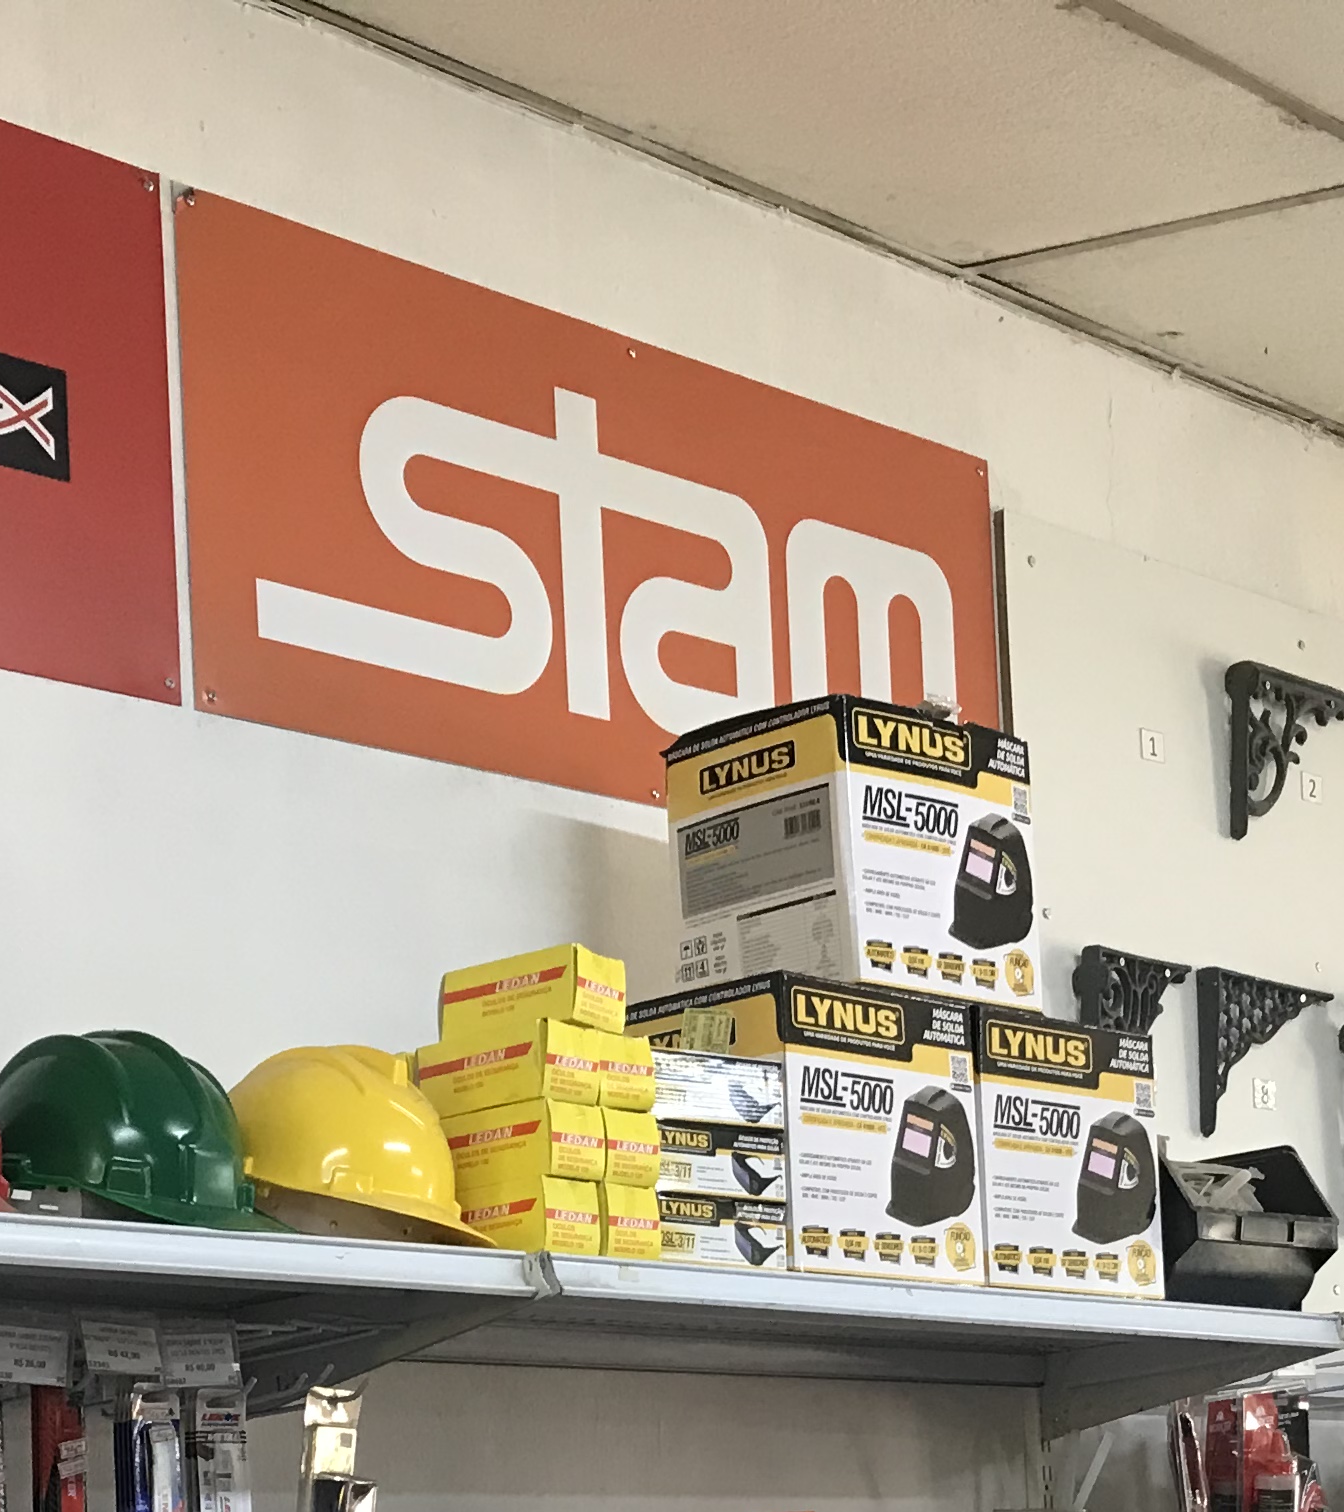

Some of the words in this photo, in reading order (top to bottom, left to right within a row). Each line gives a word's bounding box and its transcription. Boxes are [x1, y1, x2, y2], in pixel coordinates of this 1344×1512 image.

[256, 386, 955, 733] stam
[858, 715, 965, 763] LYNUS
[1149, 737, 1157, 757] 1
[702, 746, 790, 791] LYNUS
[1309, 779, 1316, 798] 2
[863, 785, 959, 838] MSL-5000
[495, 973, 540, 993] LEDAN
[584, 980, 619, 999] LEDAN
[796, 994, 898, 1038] LYNUS
[932, 1008, 963, 1022] MÁSCARA
[932, 1020, 941, 1030] DE
[942, 1022, 964, 1035] SOLDA
[923, 1030, 965, 1046] AUTOMÁTICA
[991, 1027, 1086, 1067] LYNUS
[1119, 1037, 1149, 1051] MÁSCARA
[463, 1048, 506, 1068] LEDAN
[555, 1055, 598, 1072] LEDAN
[1119, 1049, 1127, 1058] DE
[1128, 1050, 1149, 1061] SOLDA
[608, 1062, 648, 1075] LEDAN
[1110, 1058, 1150, 1073] AUTOMÁTICA
[801, 1065, 894, 1115] MSL-5000
[1262, 1085, 1268, 1105] 8
[994, 1094, 1081, 1140] MSL-5000
[469, 1126, 513, 1145] LEDAN
[560, 1133, 599, 1148] LEDAN
[659, 1131, 709, 1148] LYNUS
[617, 1141, 653, 1155] LEDAN
[468, 1204, 510, 1222] LEDAN
[555, 1209, 593, 1224] LEDAN
[661, 1200, 713, 1218] LYNUS
[617, 1216, 654, 1229] LEDAN
